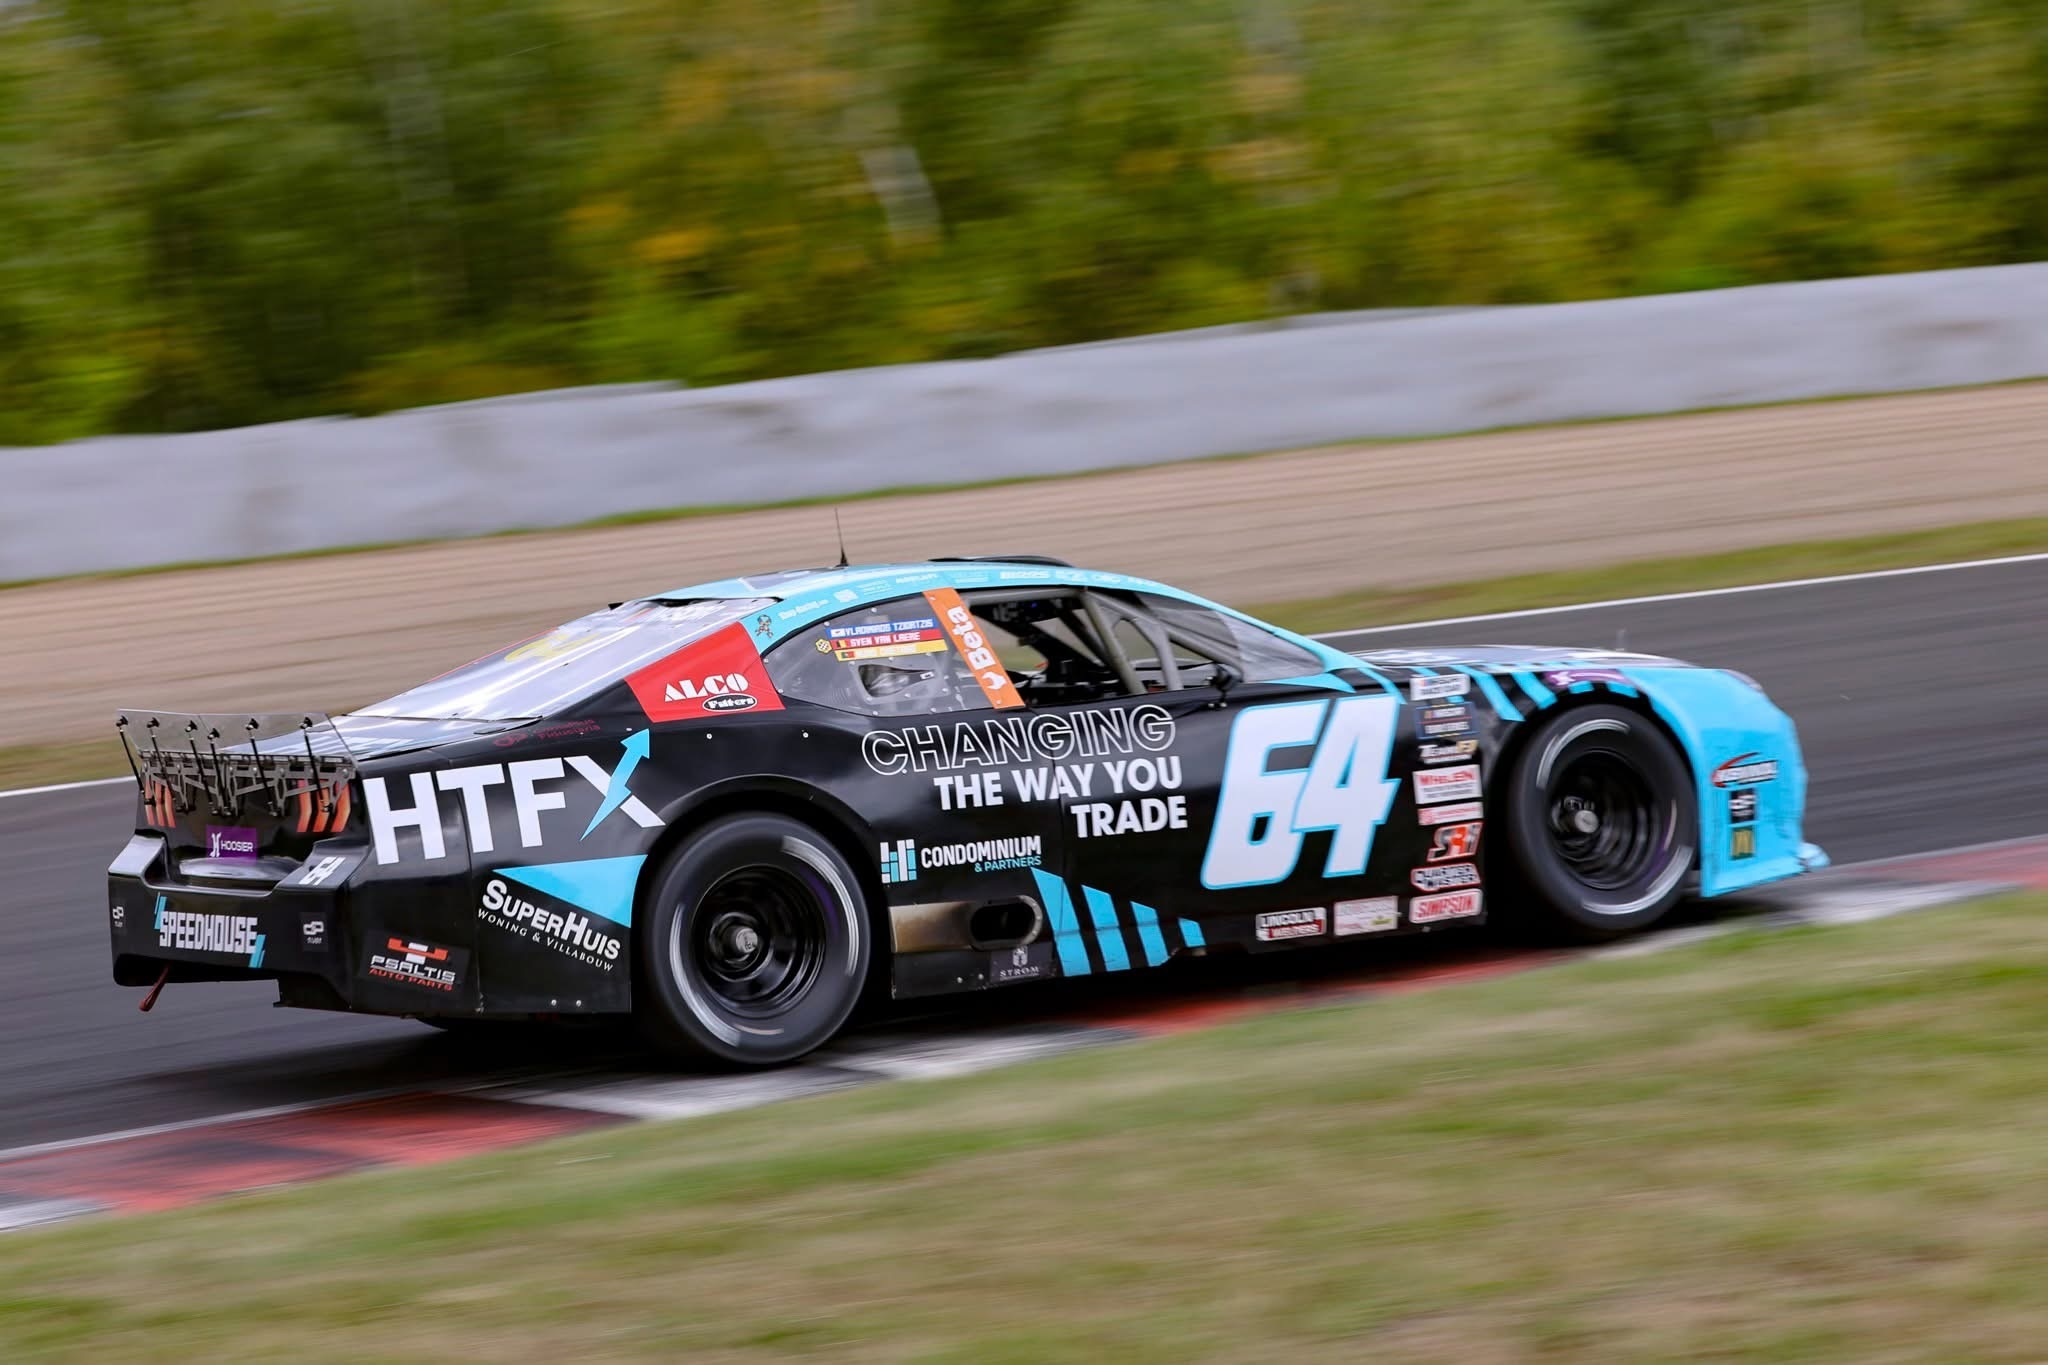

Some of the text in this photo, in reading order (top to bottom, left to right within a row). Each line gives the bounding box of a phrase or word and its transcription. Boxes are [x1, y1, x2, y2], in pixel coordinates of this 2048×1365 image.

[850, 637, 872, 648] SVEN
[874, 634, 891, 645] VAN
[946, 606, 996, 670] Beta
[664, 672, 749, 702] ALCO
[861, 704, 1176, 776] CHANGING
[362, 728, 667, 865] HTFX
[933, 755, 1183, 811] THE WAY YOU
[1200, 693, 1402, 890] 64
[1070, 795, 1188, 838] TRADE
[220, 840, 254, 852] HOOSIER
[920, 835, 1042, 869] CONDOMINIUM
[974, 856, 1042, 873] & PARTNERS
[1260, 910, 1315, 929] LINCOLN
[1418, 895, 1473, 918] SIMPSON
[160, 910, 258, 955] SPEEDHOUSE
[477, 908, 614, 972] WONING & VILLABOUW
[368, 968, 453, 991] AUTO PARTS
[371, 955, 456, 982] PSALTIS
